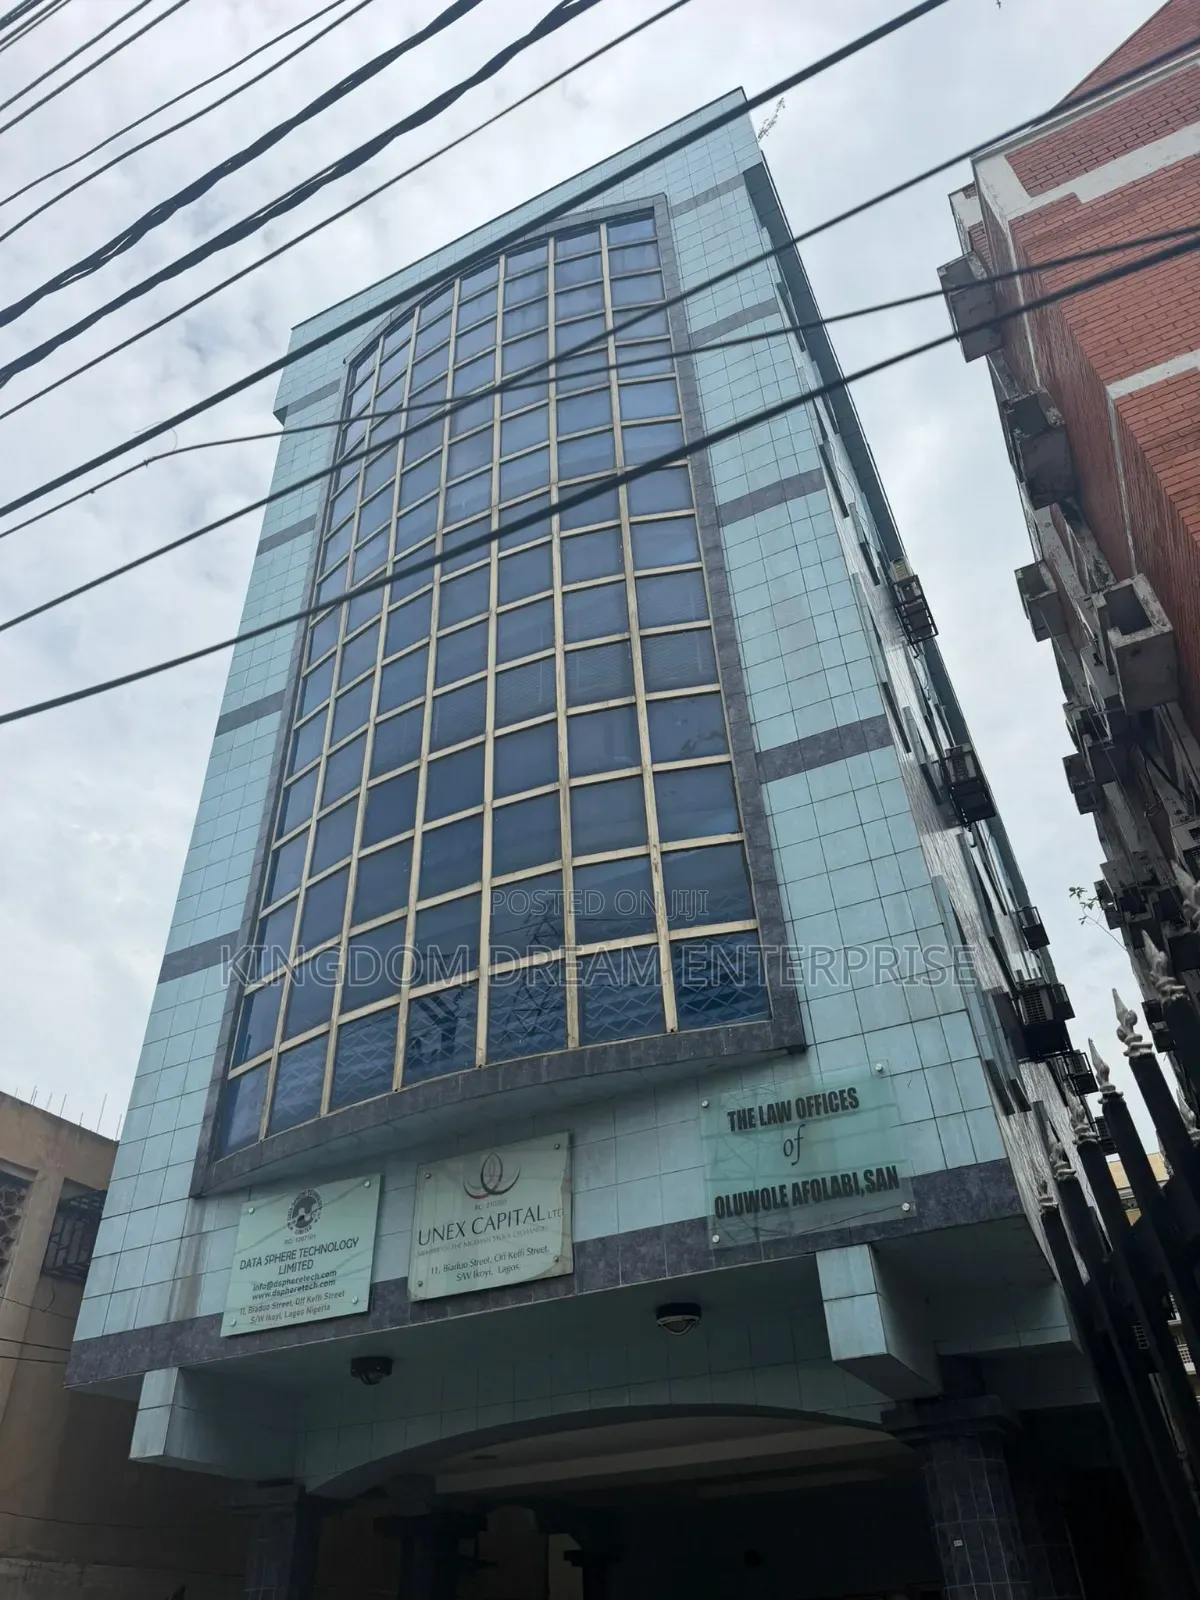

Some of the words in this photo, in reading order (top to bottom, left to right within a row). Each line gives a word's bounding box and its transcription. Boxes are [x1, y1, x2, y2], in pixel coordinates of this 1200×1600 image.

[727, 1107, 757, 1132] THE
[759, 1100, 792, 1126] LAW
[795, 1087, 860, 1120] OFFICES
[783, 1124, 806, 1166] of
[714, 1184, 789, 1220] OLUWOLE
[418, 1220, 466, 1246] UNEX
[471, 1204, 546, 1235] CAPITAL
[239, 1256, 263, 1271] DATA
[264, 1249, 298, 1266] SPHERE
[299, 1236, 360, 1259] TECHNOLOGY
[494, 1251, 507, 1263] Off
[508, 1248, 525, 1260] Keffi
[278, 1259, 315, 1276] LIMITED
[252, 1270, 338, 1292] info@dspheretech.com
[252, 1279, 337, 1301] www.dspheretech.com
[295, 1297, 306, 1306] Off
[324, 1290, 346, 1301] Street
[284, 1309, 305, 1319] Lagos
[306, 1304, 331, 1315] Nigeria
